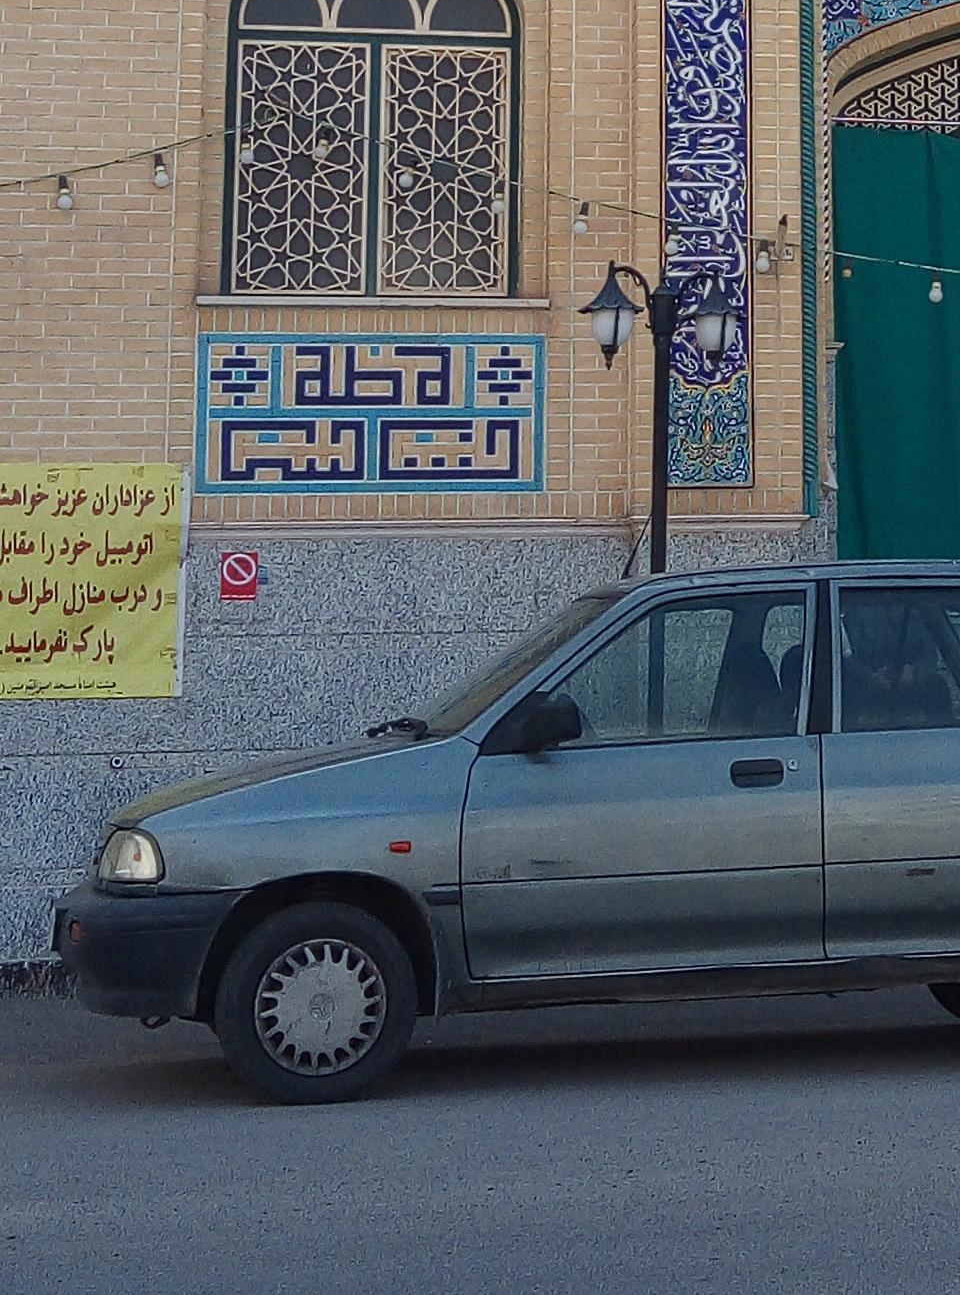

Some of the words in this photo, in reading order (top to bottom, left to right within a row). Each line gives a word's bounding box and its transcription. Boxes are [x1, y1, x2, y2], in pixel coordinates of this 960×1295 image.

[51, 488, 88, 517] عزیز
[92, 483, 156, 517] عزاداران
[160, 483, 176, 517] از
[41, 531, 55, 566] را
[60, 532, 92, 566] خود
[8, 575, 59, 615] اطراف
[63, 580, 106, 616] منازل
[110, 582, 148, 613] درب
[151, 587, 163, 612] و
[72, 624, 115, 665] پارک
